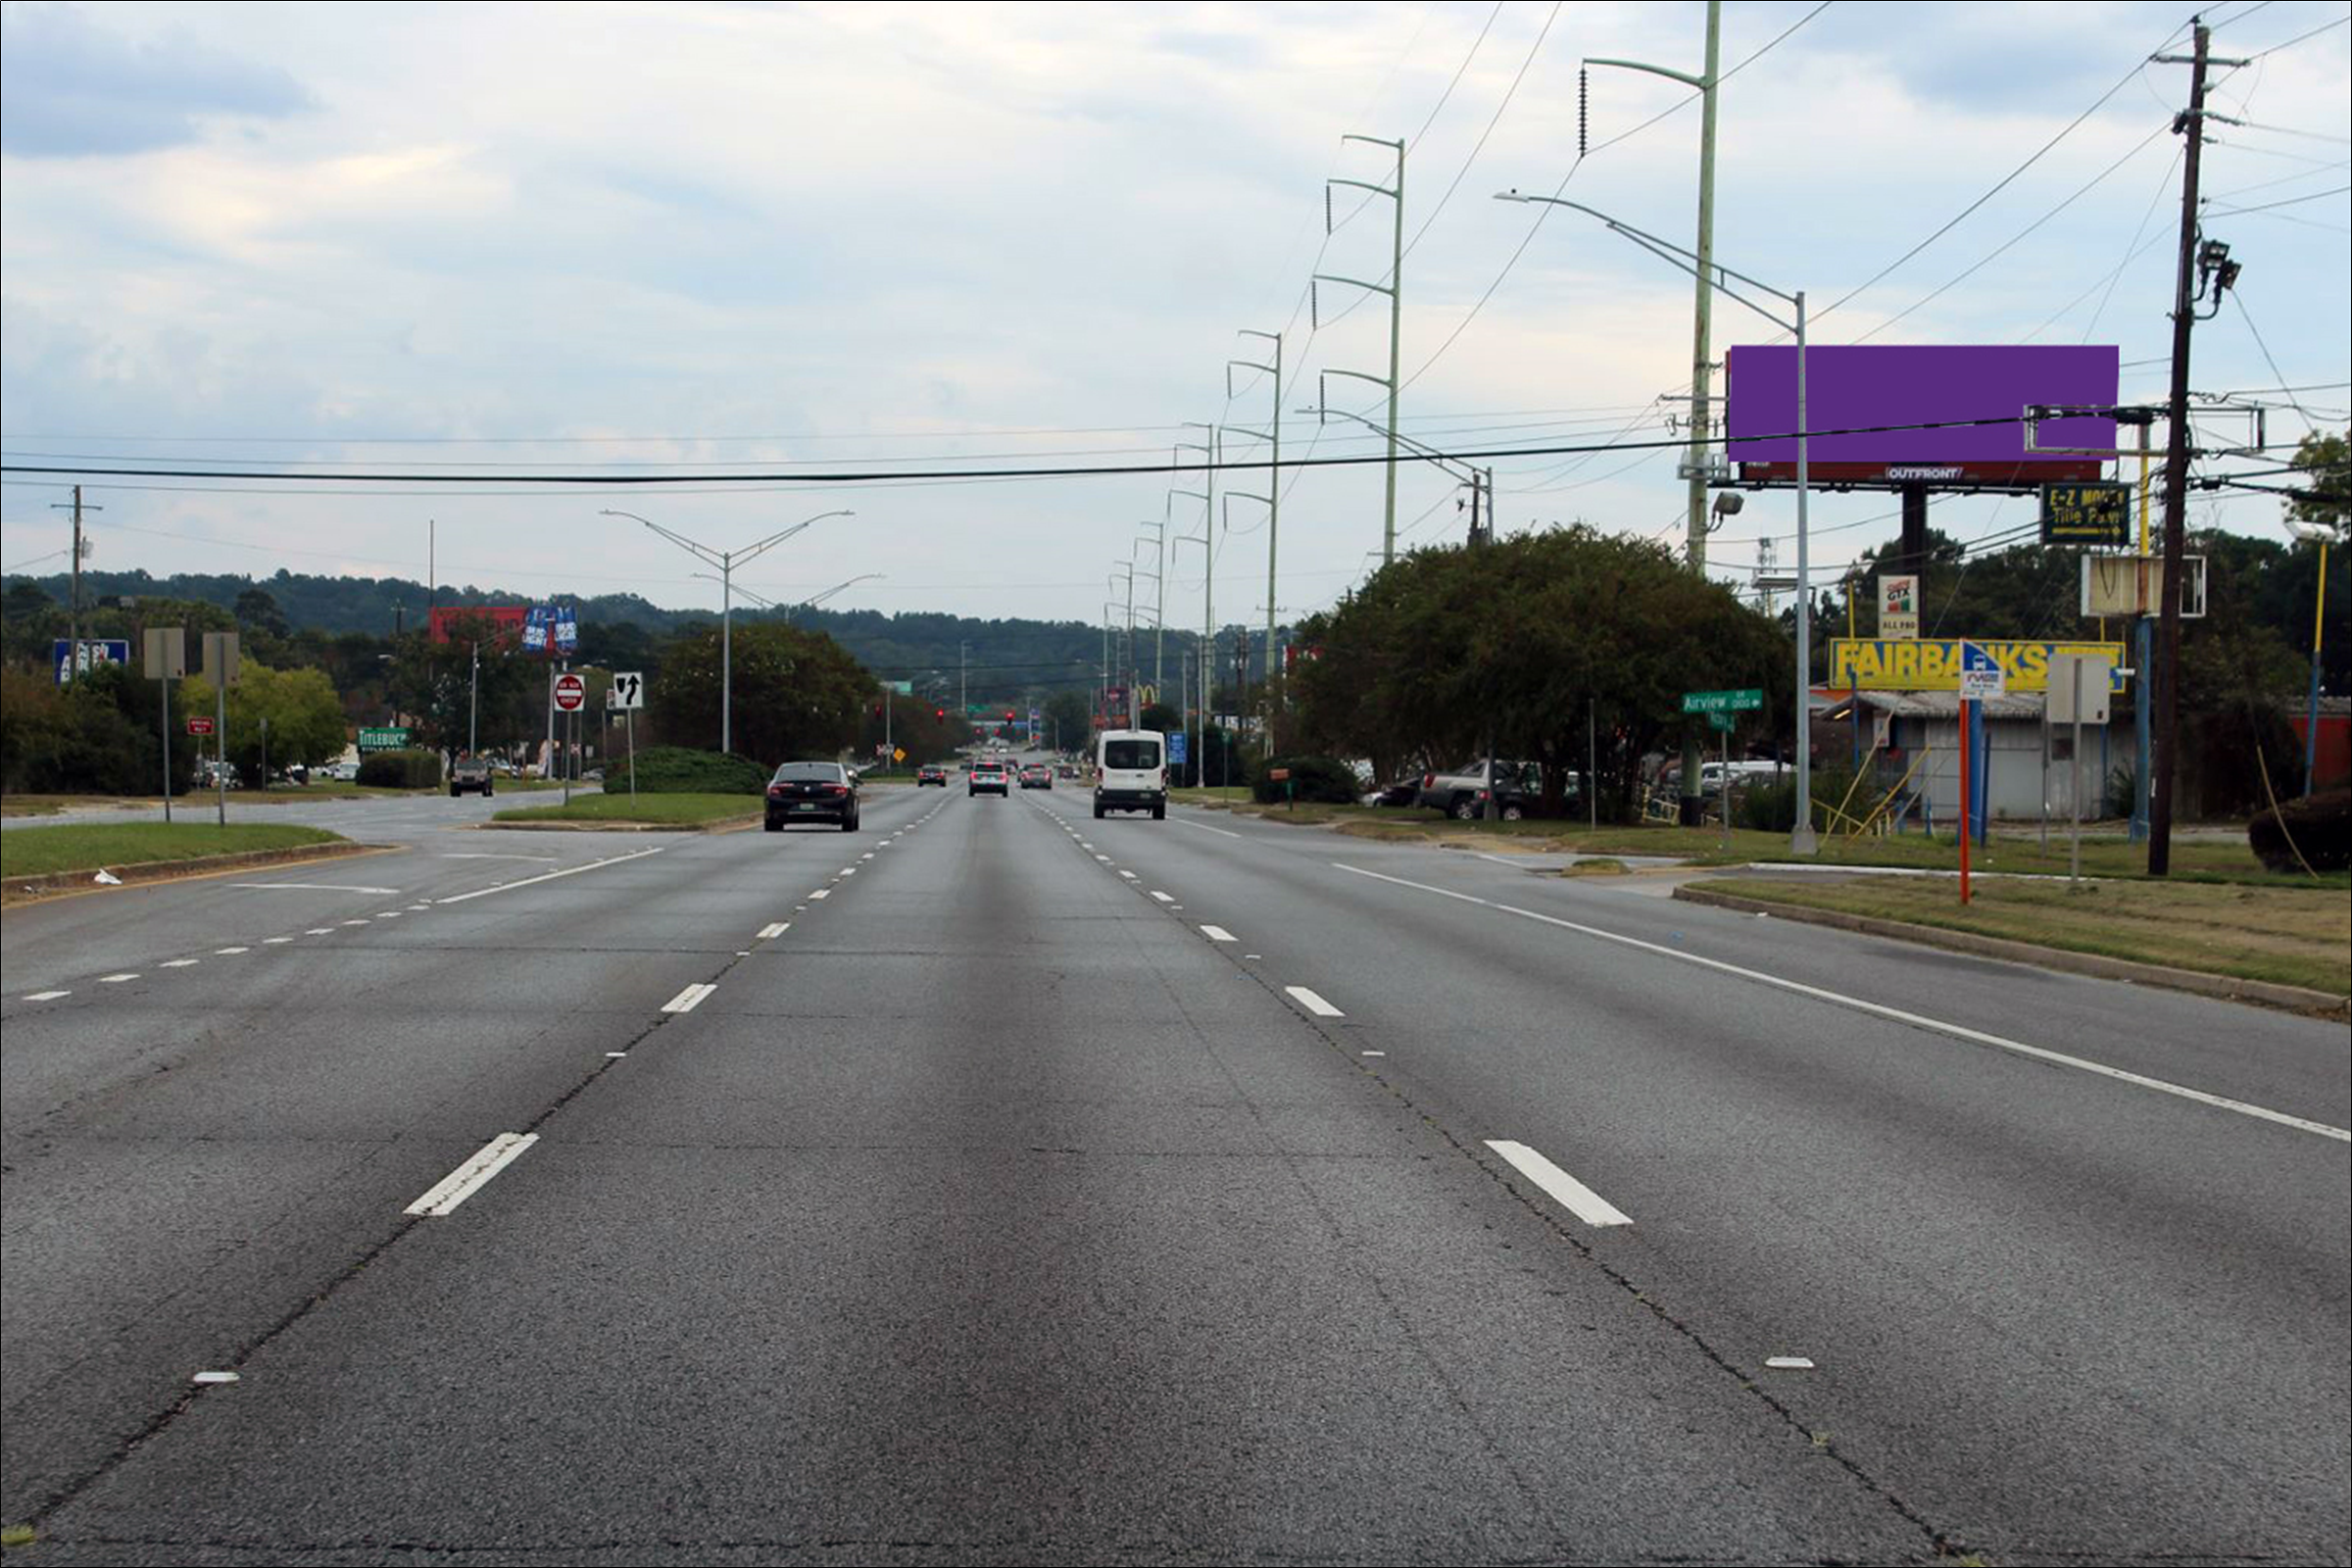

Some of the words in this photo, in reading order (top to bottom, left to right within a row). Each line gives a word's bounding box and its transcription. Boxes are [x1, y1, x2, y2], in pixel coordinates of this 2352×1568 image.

[1888, 468, 1958, 479] OUTFRONT
[2050, 489, 2076, 506] E-Z
[1887, 589, 1910, 601] GTX
[1684, 695, 1726, 711] Airview
[359, 730, 408, 745] TITLEBUC
